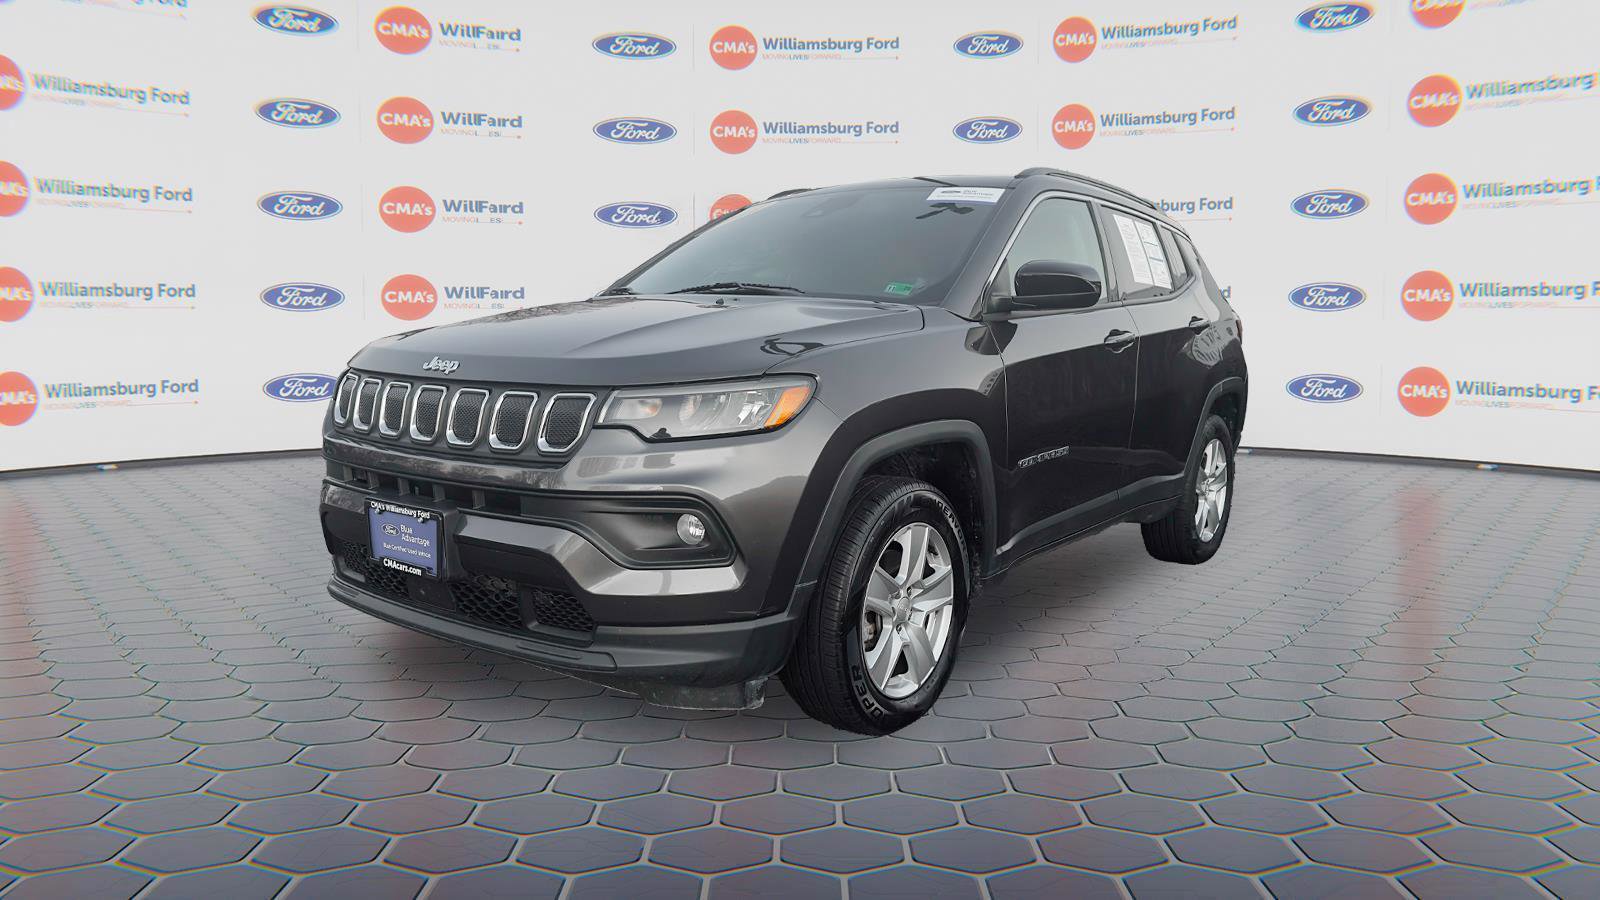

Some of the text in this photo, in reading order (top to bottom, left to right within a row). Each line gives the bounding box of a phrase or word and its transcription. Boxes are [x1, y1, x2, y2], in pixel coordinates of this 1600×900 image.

[269, 8, 321, 32] Ford
[1310, 5, 1357, 28] Ford
[377, 21, 430, 38] CMA's
[1101, 16, 1237, 40] Williamsburg Ford
[610, 36, 660, 56] Ford
[713, 41, 755, 54] CMA's
[763, 37, 899, 53] Williamsburg Ford
[968, 35, 1008, 54] Ford
[1055, 33, 1094, 47] CMA's
[33, 74, 147, 104] Williamsburg
[152, 87, 190, 105] Ford
[1466, 74, 1594, 99] Williamsburg
[1410, 92, 1459, 109] CMA's
[271, 101, 323, 124] Ford
[380, 112, 431, 128] CMA's
[1100, 107, 1236, 127] Williamsburg Ford
[1307, 101, 1355, 121] Ford
[610, 121, 660, 140] Ford
[713, 125, 755, 138] CMA's
[763, 121, 899, 137] Williamsburg Ford
[967, 121, 1008, 139] Ford
[1055, 120, 1093, 133] CMA's
[37, 178, 150, 203] Williamsburg
[155, 186, 193, 201] Ford
[1406, 192, 1454, 206] CMA's
[1462, 180, 1590, 199] Williamsburg
[274, 194, 325, 216] Ford
[382, 202, 432, 217] CMA's
[1200, 196, 1233, 211] Ford
[1305, 194, 1353, 215] Ford
[611, 206, 660, 223] Ford
[40, 281, 196, 301] Williamsburg Ford
[277, 286, 327, 306] Ford
[384, 290, 434, 304] CMA's
[1303, 286, 1349, 306] Ford
[1403, 289, 1451, 303] CMA's
[1459, 281, 1586, 300] Williamsburg
[422, 357, 460, 374] Jeep
[45, 379, 199, 398] Williamsburg Ford
[279, 378, 330, 397] Ford
[1301, 378, 1348, 399] Ford
[1400, 384, 1448, 399] CMA's
[1456, 380, 1581, 403] Williamsburg
[401, 534, 430, 547] Advantage
[383, 558, 422, 576] CMAcars.com
